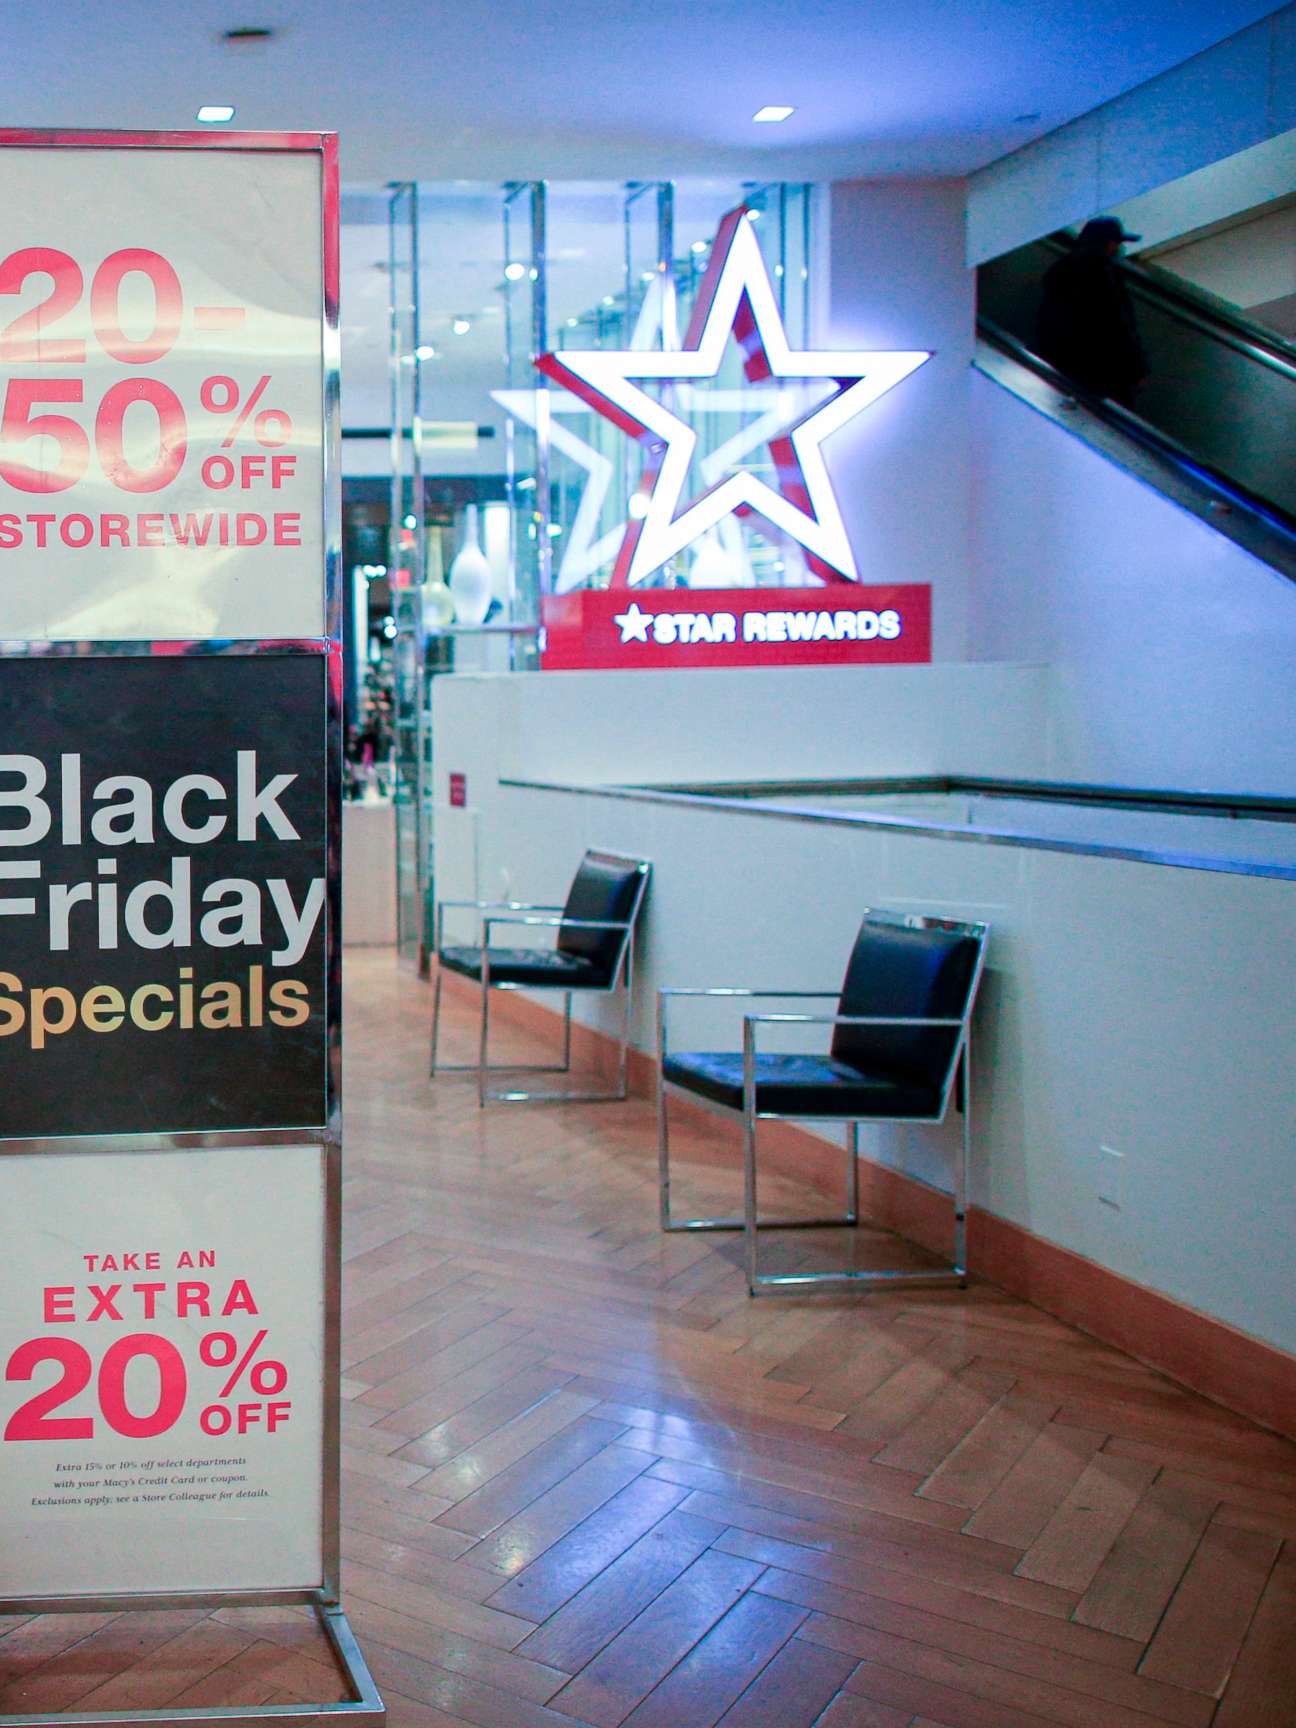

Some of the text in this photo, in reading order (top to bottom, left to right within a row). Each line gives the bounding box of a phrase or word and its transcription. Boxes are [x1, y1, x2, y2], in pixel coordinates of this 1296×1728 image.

[201, 455, 297, 490] OFF
[653, 609, 902, 644] STAR REWARDS
[83, 1250, 216, 1273] TAKE AN
[43, 1279, 259, 1323] EXTRA
[4, 1330, 288, 1442] 20%
[199, 1402, 292, 1436] OFF
[56, 1463, 82, 1472] Extra
[141, 1460, 155, 1471] off
[157, 1459, 183, 1468] select
[186, 1457, 246, 1469] departments
[32, 1496, 82, 1506] Exclusions
[142, 1493, 166, 1502] Store
[169, 1491, 217, 1502] Colleague
[219, 1491, 232, 1501] for
[54, 1480, 75, 1488] with
[77, 1480, 99, 1489] your
[102, 1478, 135, 1488] Macy's
[138, 1476, 168, 1486] Credit
[171, 1475, 195, 1484] Card
